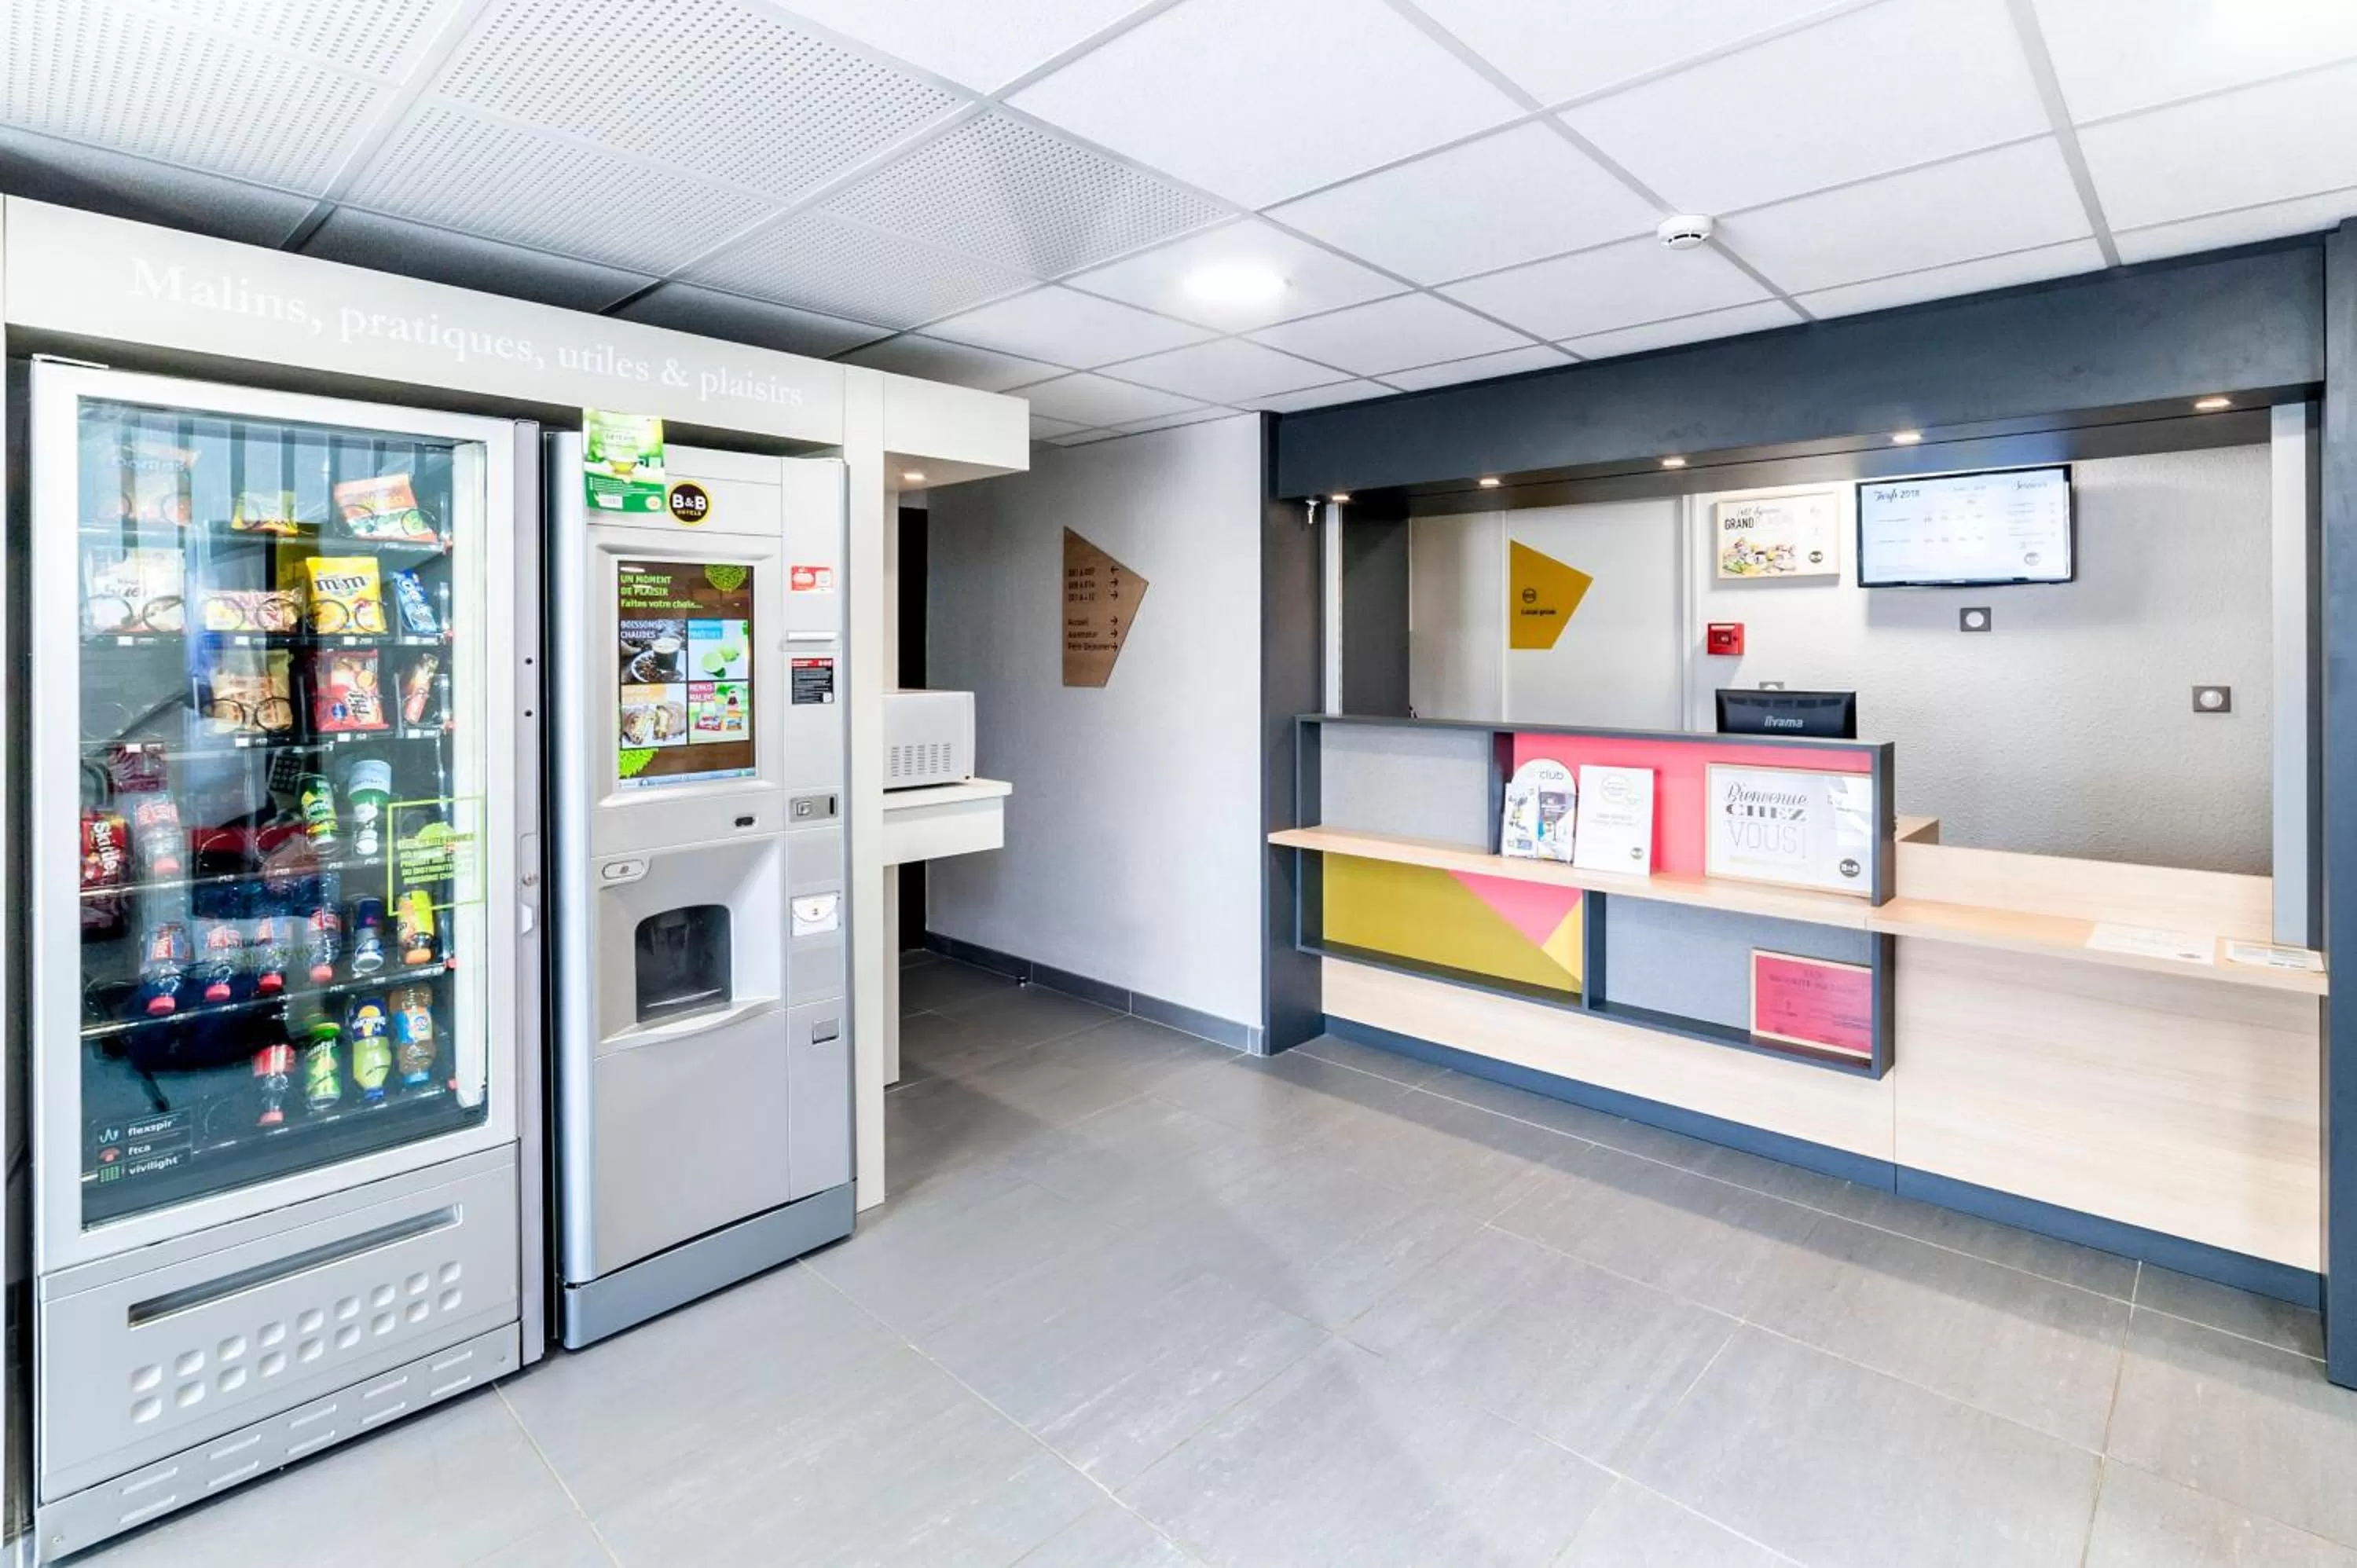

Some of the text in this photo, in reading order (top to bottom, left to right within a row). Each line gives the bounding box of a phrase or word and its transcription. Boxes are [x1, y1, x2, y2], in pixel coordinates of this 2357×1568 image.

[126, 256, 804, 408] Malins, pratiques, utiles & plaisirs
[672, 493, 706, 511] B&B
[1725, 516, 1754, 530] GRAND
[1764, 715, 1804, 728] iiyama
[1539, 770, 1564, 781] club
[1725, 780, 1809, 806] Bienvenue
[1725, 804, 1808, 822] CHEZ
